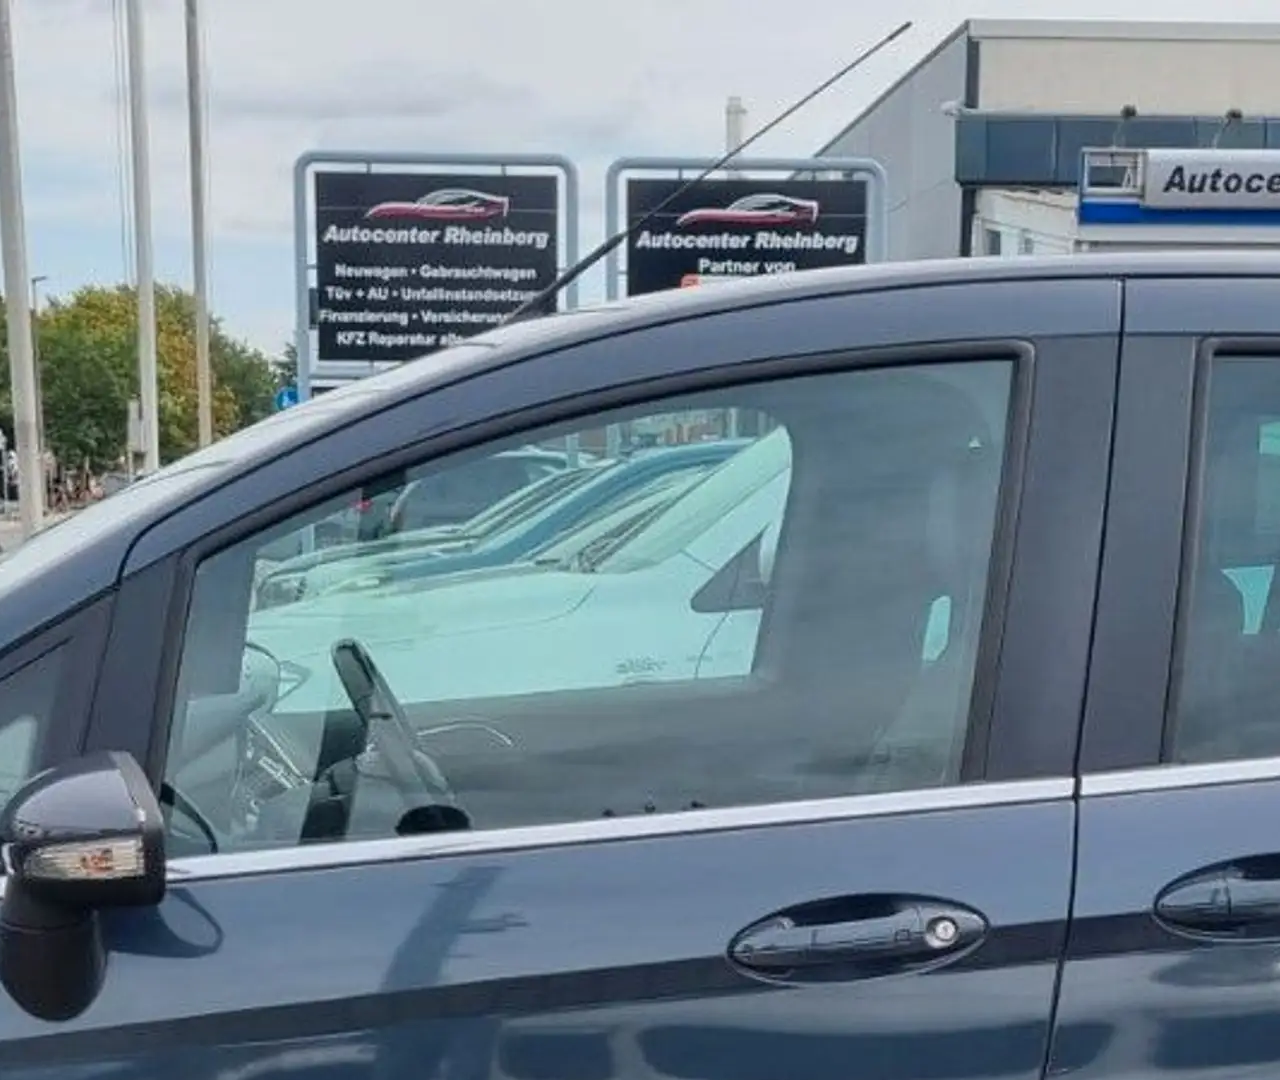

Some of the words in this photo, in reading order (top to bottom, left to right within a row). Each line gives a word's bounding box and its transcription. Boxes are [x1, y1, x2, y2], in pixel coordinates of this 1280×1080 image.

[324, 224, 440, 244] Autocenter
[443, 226, 549, 249] Rheinberg
[636, 230, 750, 249] Autocenter
[755, 231, 858, 253] Rheinberg
[335, 264, 408, 280] Neuwagen
[698, 257, 759, 273] Partner
[367, 286, 389, 300] AU
[319, 309, 408, 326] Finanzierung
[336, 331, 365, 345] KFZ
